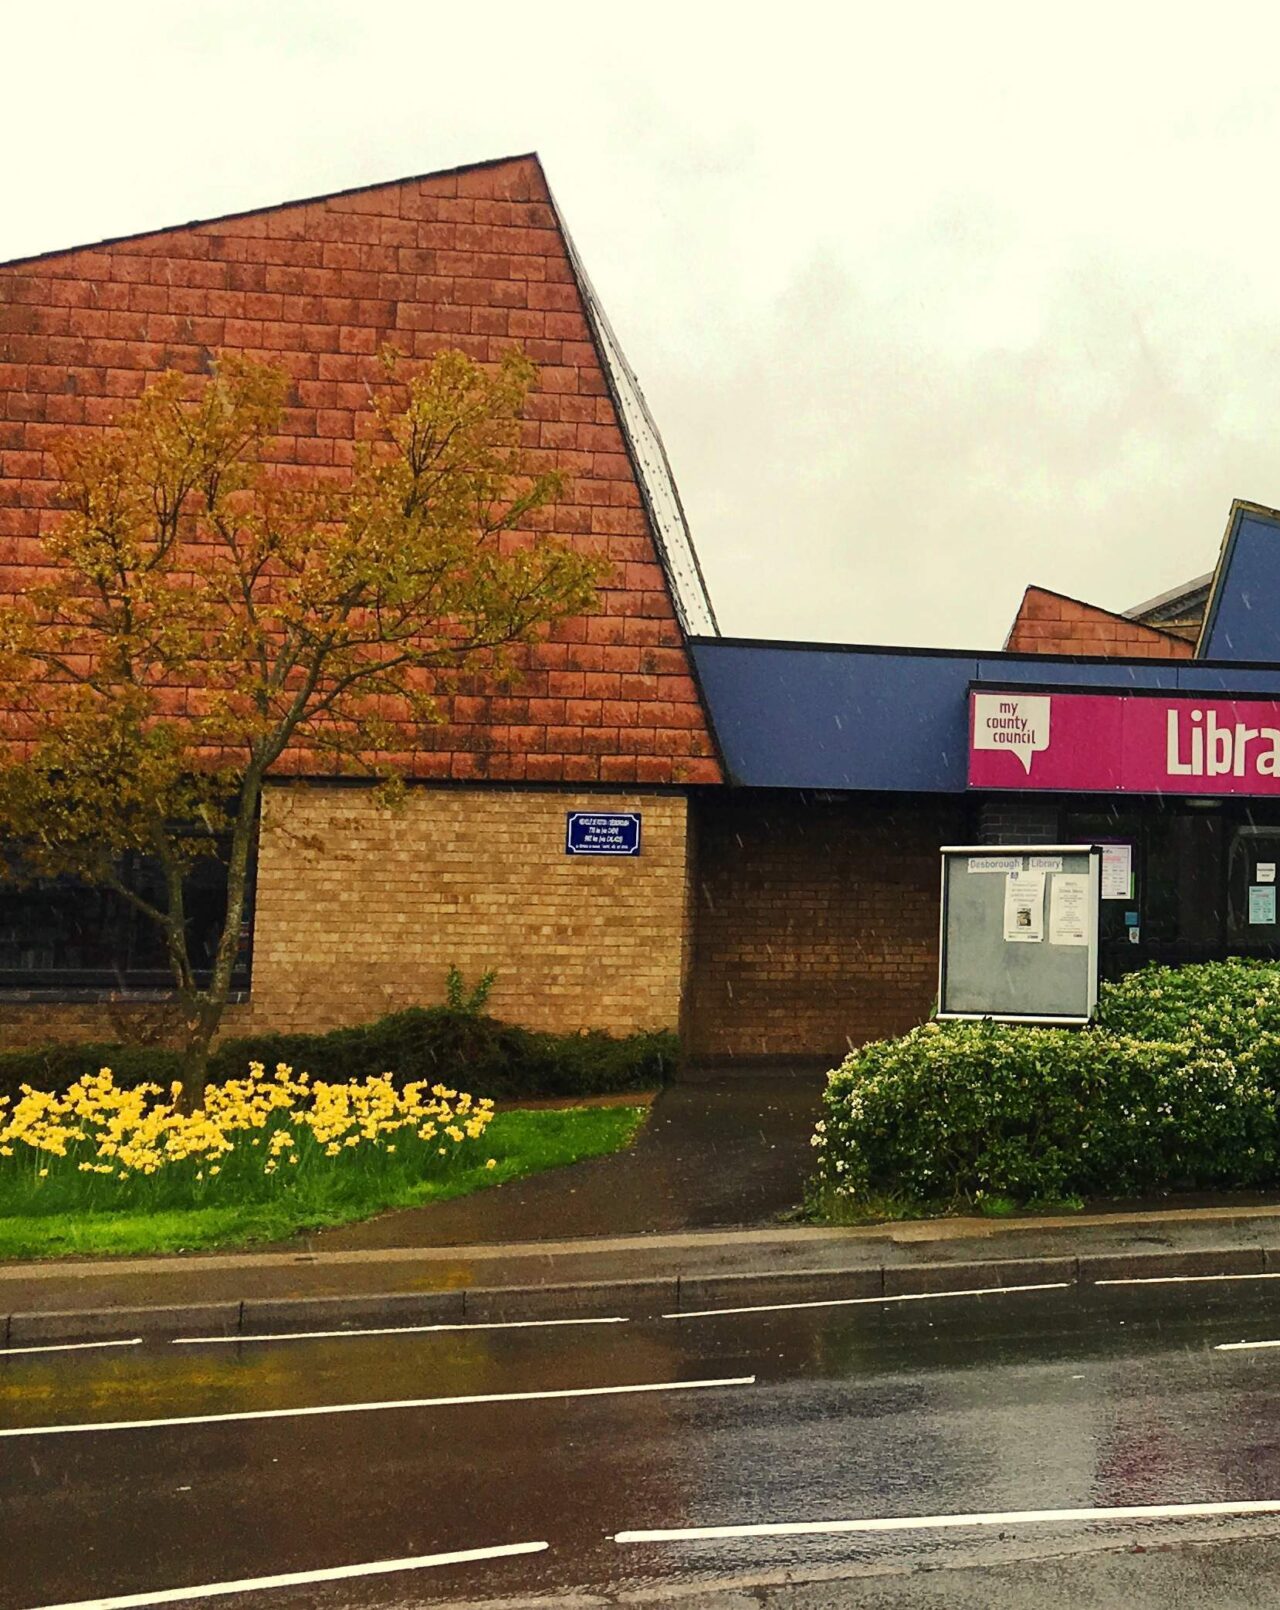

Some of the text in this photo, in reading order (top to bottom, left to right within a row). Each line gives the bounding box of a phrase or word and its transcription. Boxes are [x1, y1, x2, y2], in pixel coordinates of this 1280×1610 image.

[999, 701, 1019, 716] my
[986, 716, 1028, 731] county
[993, 730, 1036, 745] council
[970, 859, 1061, 870] Desborough Library
